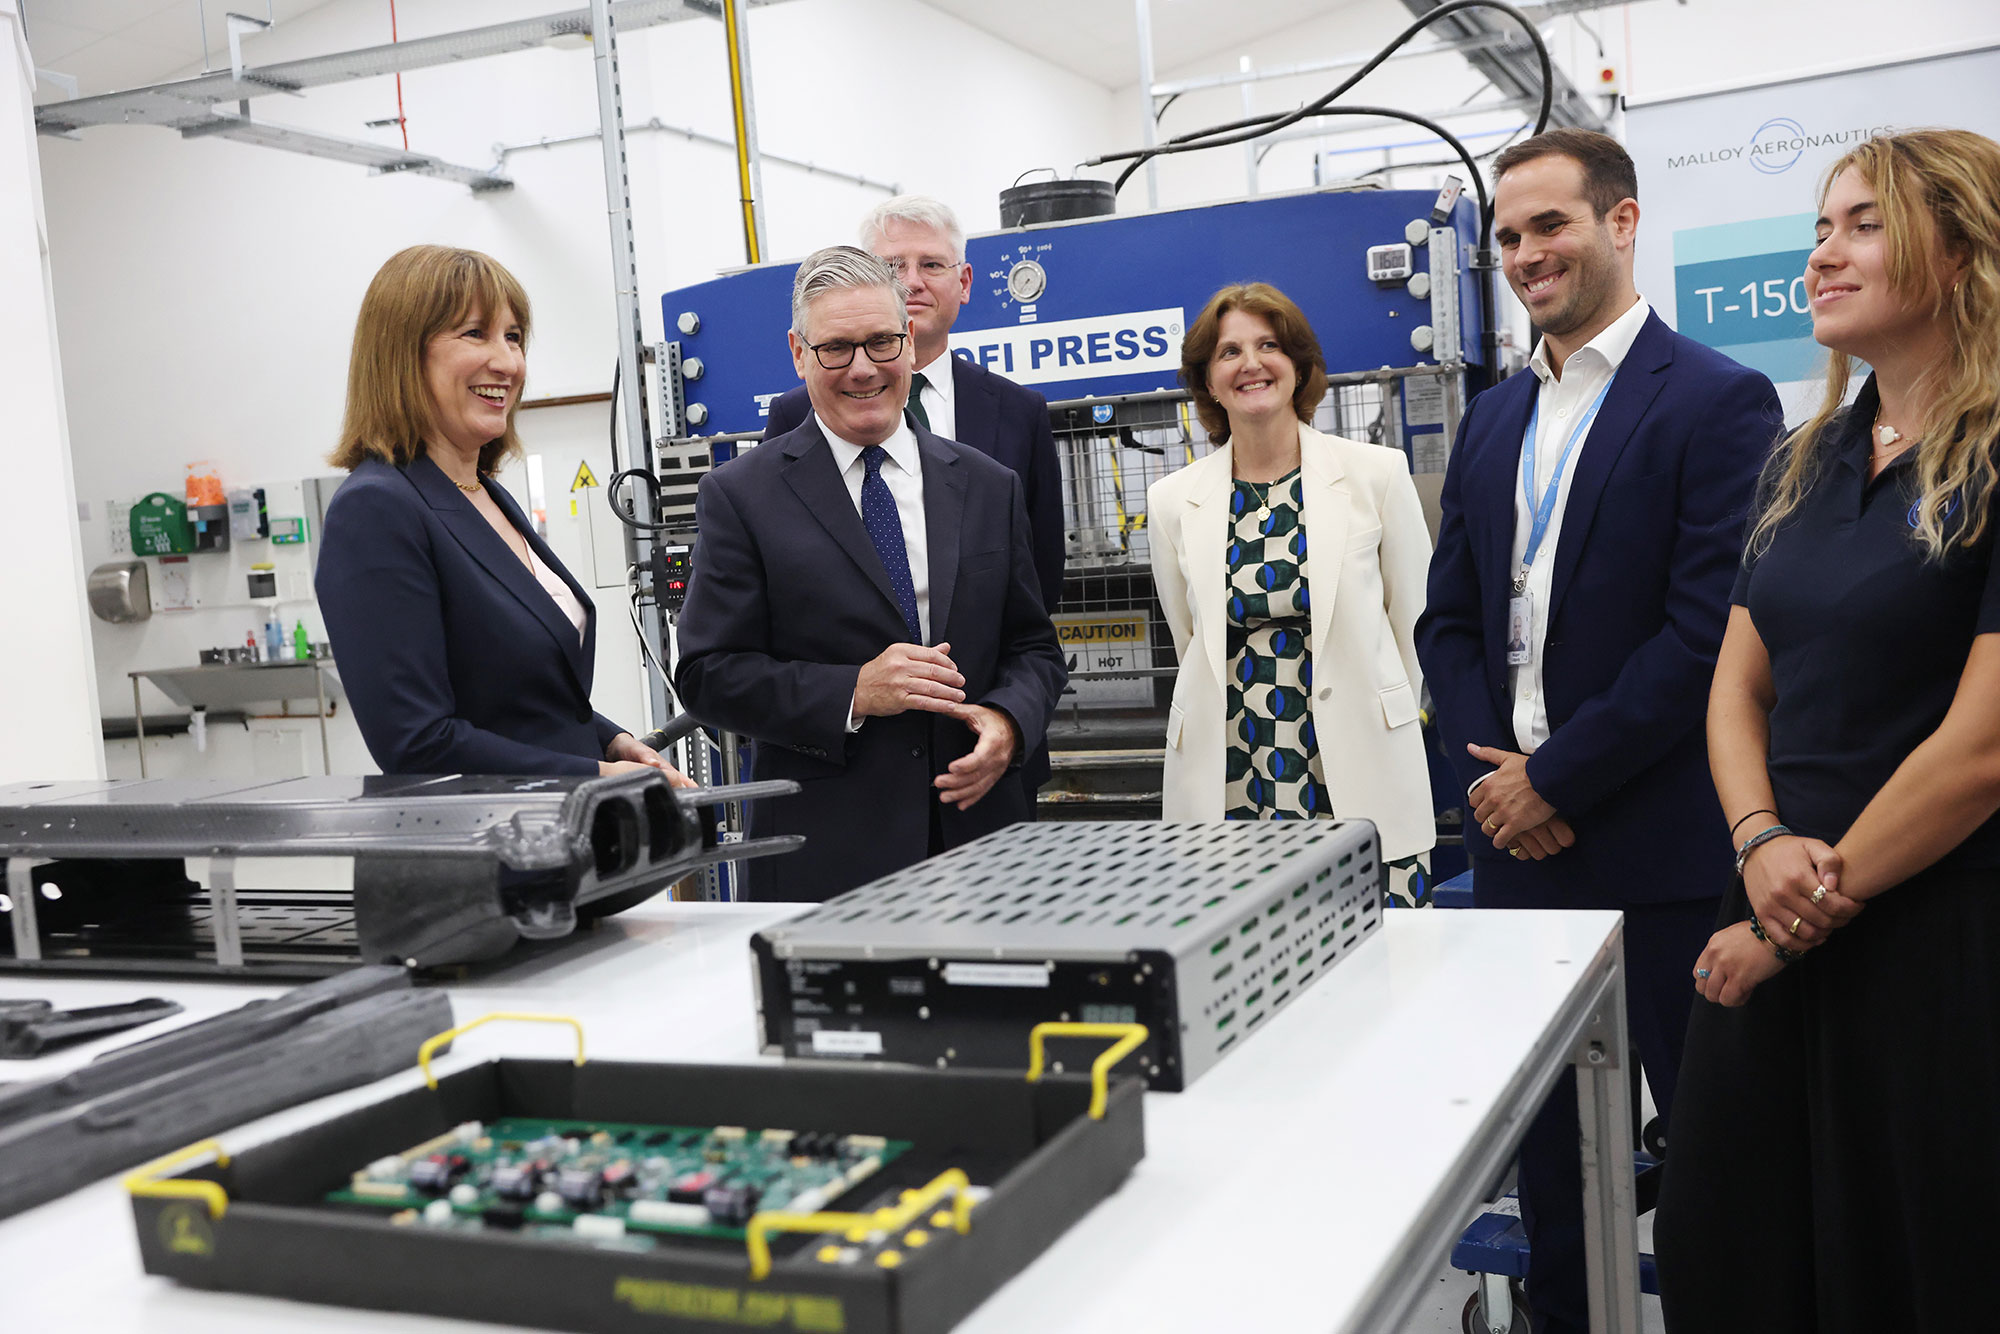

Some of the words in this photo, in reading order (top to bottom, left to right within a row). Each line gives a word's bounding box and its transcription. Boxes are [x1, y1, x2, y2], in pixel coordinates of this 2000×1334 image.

[1667, 146, 1744, 169] MALLOY
[1750, 125, 1896, 156] AERONAUTICS
[1694, 276, 1811, 324] T-150
[1030, 325, 1169, 370] PRESS
[1058, 623, 1136, 641] CAUTION
[1098, 656, 1123, 668] HOT
